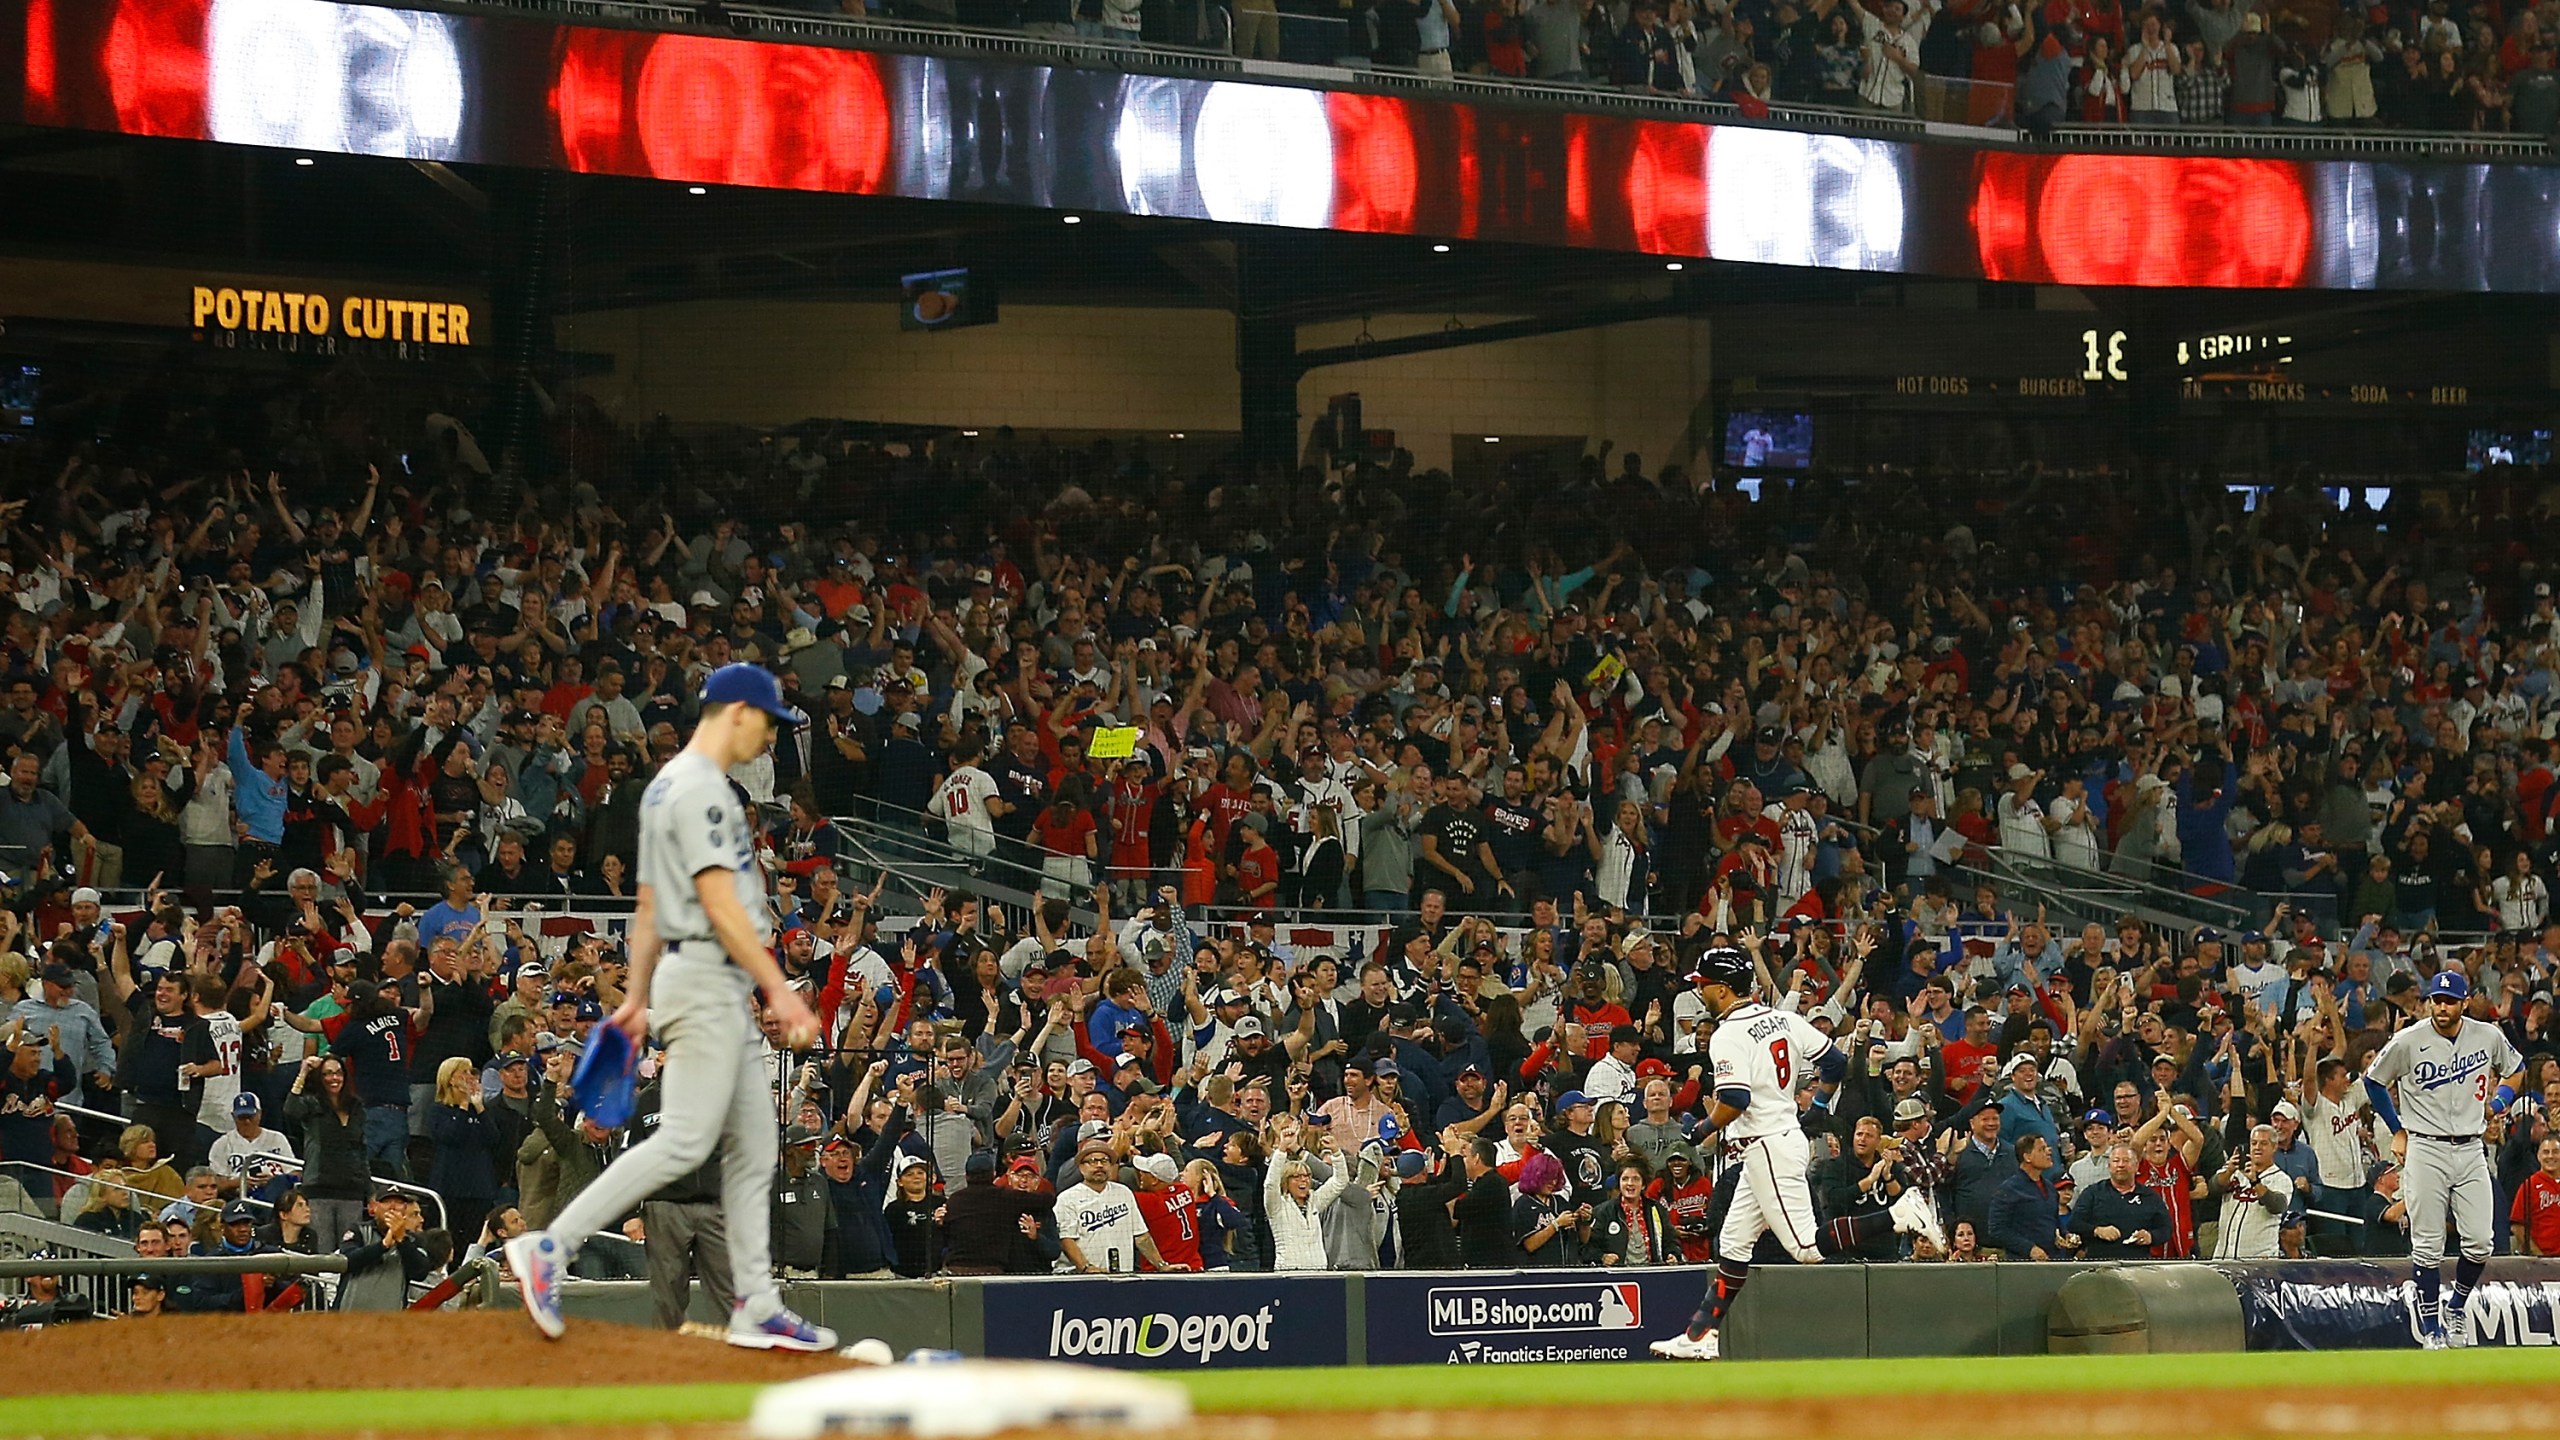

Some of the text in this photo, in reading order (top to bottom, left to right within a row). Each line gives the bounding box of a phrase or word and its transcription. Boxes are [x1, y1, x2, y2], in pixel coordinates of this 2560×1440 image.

[193, 286, 330, 336] POTATO
[342, 296, 470, 345] CUTTER
[1897, 377, 2468, 404] HOT DOGS BURGERS SNACKS SODA BEER
[947, 787, 969, 817] 10
[1494, 807, 1530, 828] BRAVES
[219, 1041, 241, 1076] 13
[384, 1030, 401, 1061] 1
[1769, 1037, 1791, 1091] 8
[2414, 1049, 2489, 1087] Dodgers
[2475, 1074, 2487, 1101] 3
[1080, 1203, 1129, 1228] Dodgers
[1165, 1190, 1193, 1213] ALBES
[1176, 1208, 1193, 1240] 1
[1050, 1305, 1274, 1364] loanDepot
[1447, 1345, 1628, 1365] A Fanatics Experience
